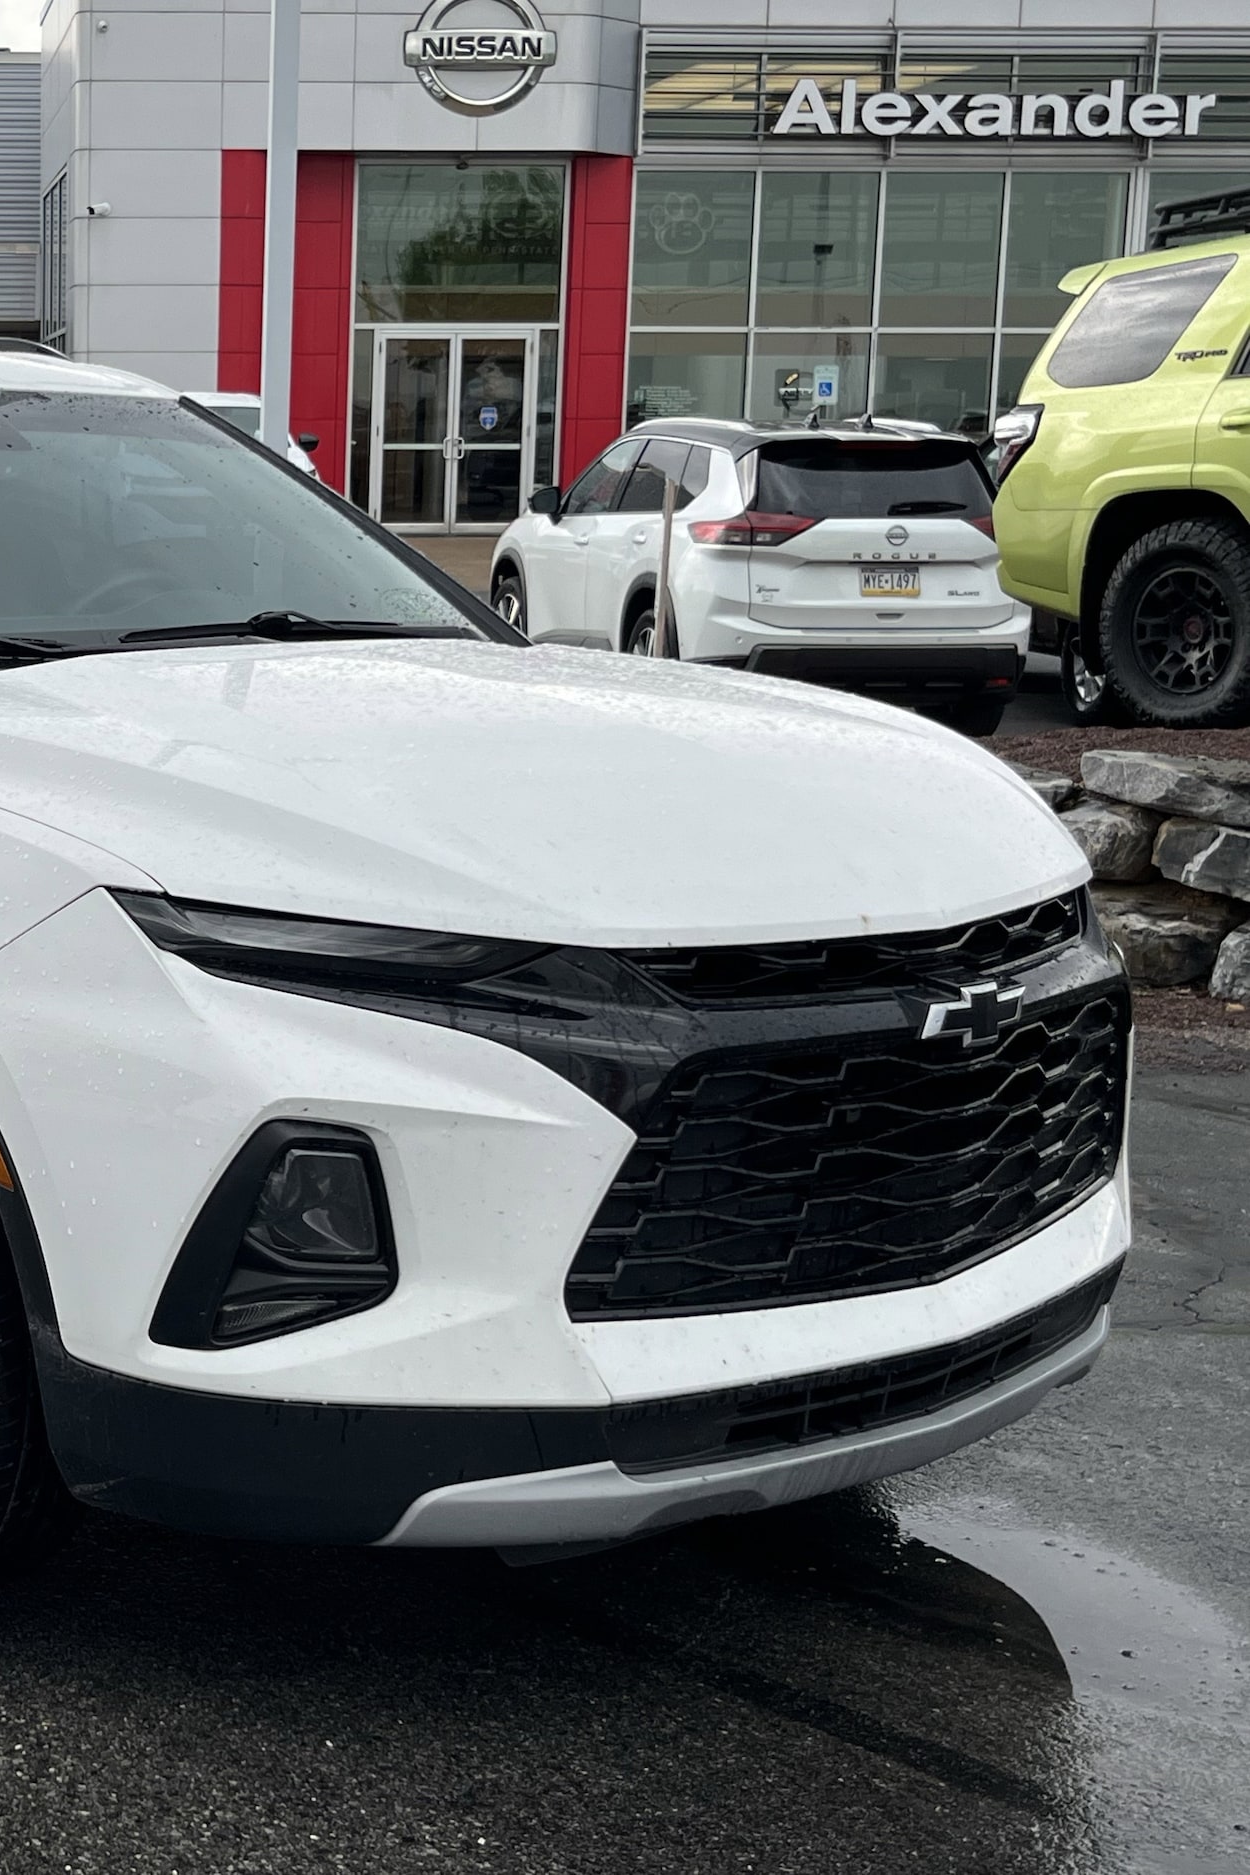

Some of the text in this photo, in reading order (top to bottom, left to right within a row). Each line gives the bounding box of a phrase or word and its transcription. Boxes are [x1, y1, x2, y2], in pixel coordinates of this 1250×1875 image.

[421, 36, 543, 59] NISSAN
[771, 79, 1217, 137] Alexander
[853, 552, 937, 560] ROGUE
